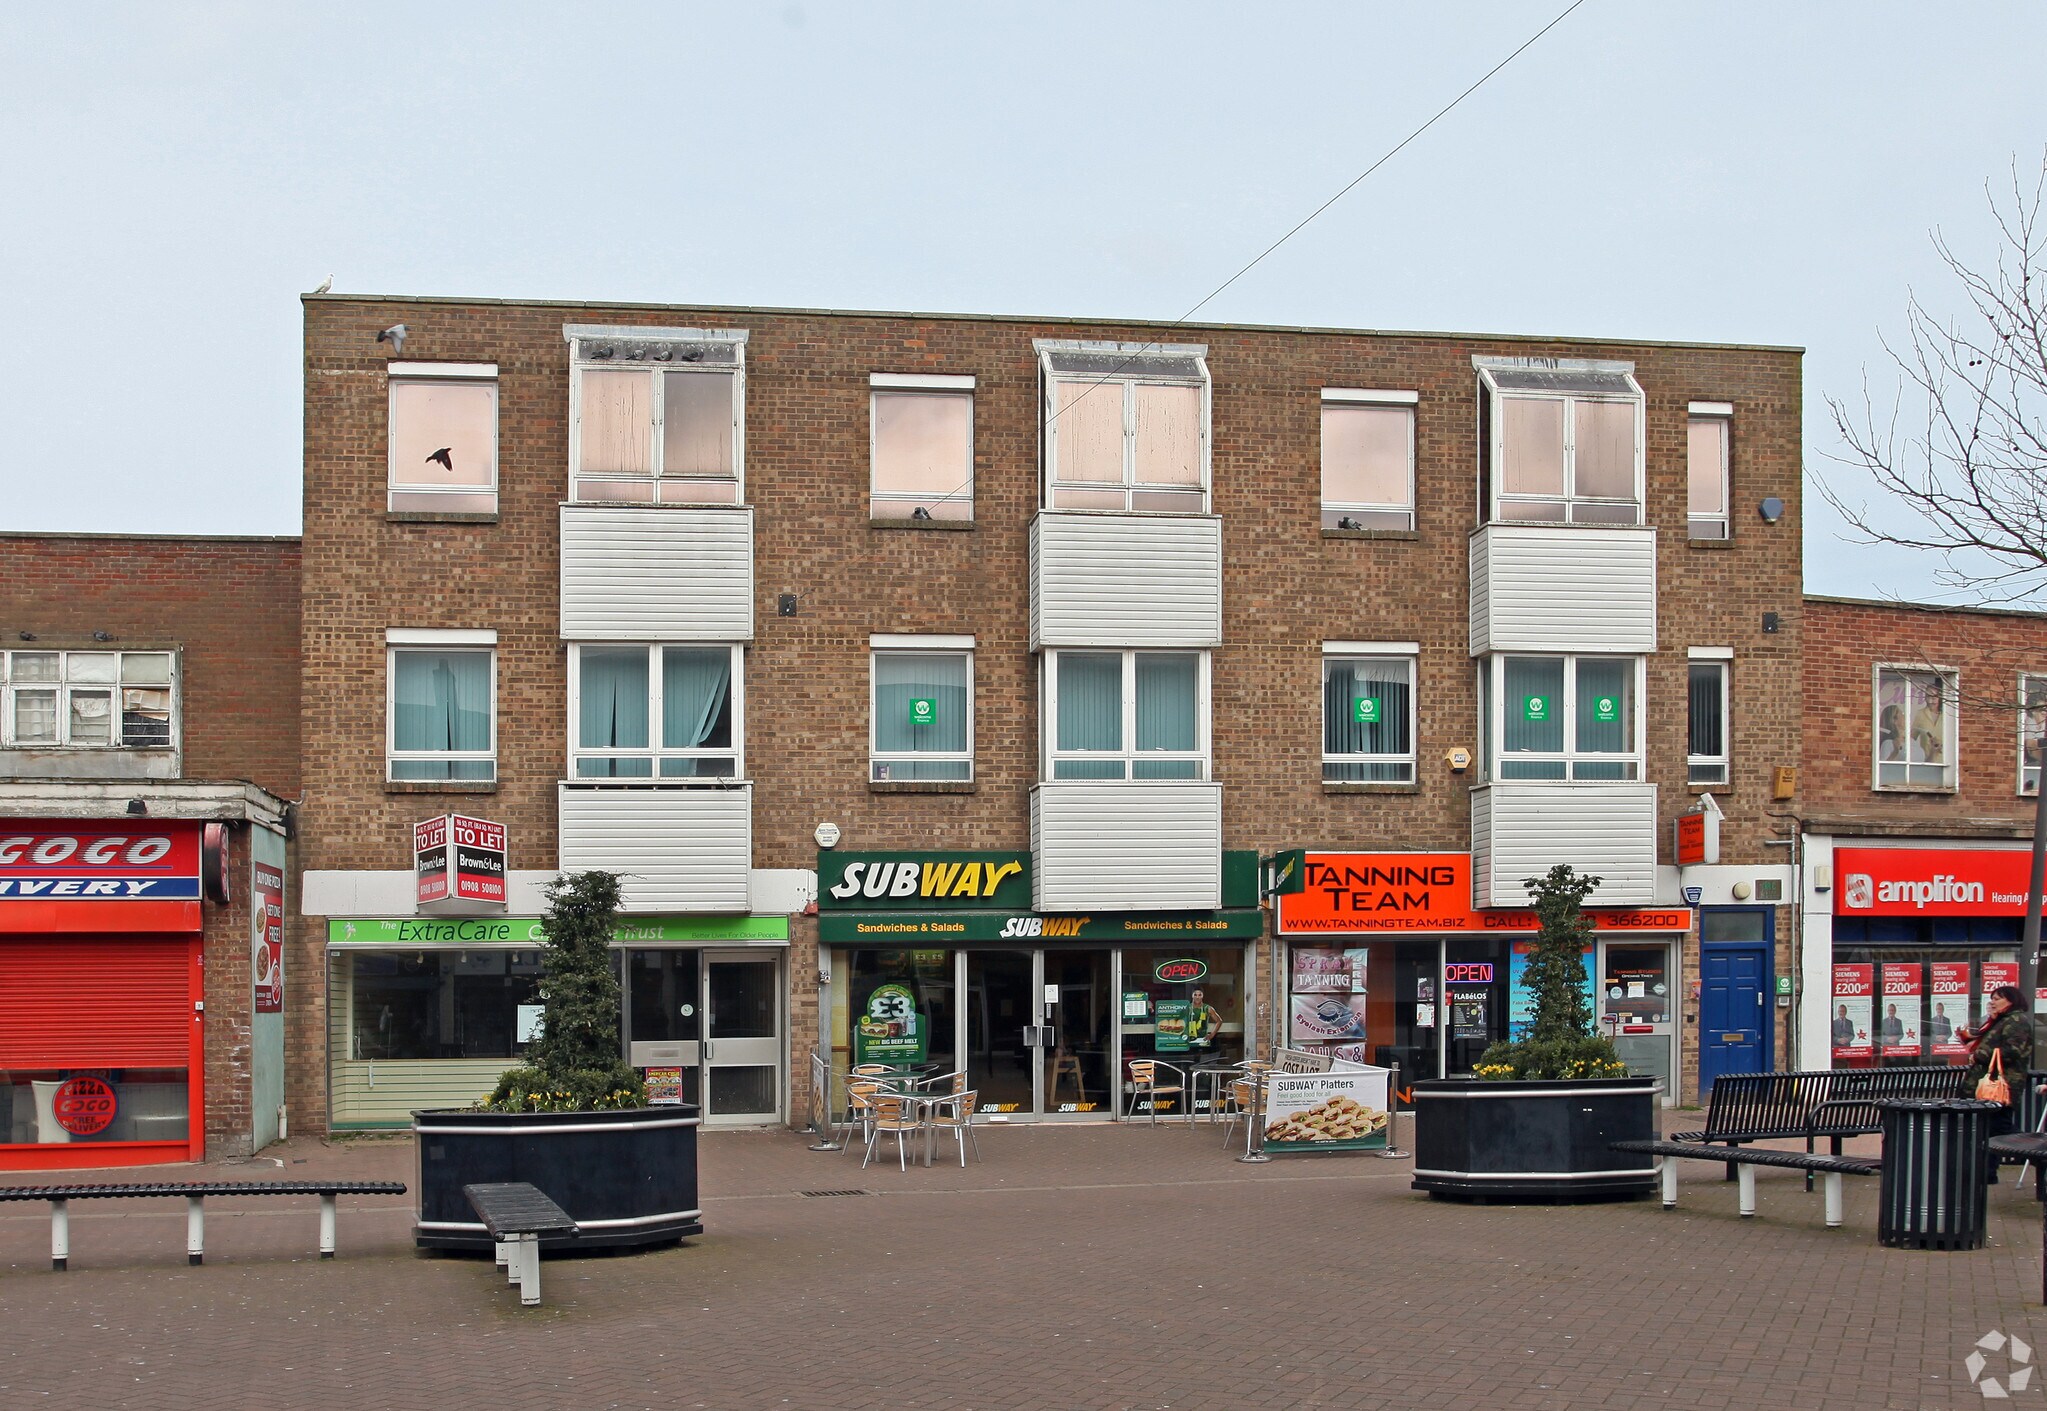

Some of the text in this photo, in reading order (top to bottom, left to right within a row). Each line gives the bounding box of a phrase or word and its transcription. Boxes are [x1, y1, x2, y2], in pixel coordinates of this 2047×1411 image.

[417, 828, 445, 850] TO LET
[455, 827, 475, 844] TO
[480, 832, 502, 849] LET
[0, 837, 172, 864] GOGO
[460, 854, 501, 871] Brown&Lee
[830, 860, 1022, 899] SUBWAY
[1305, 863, 1454, 886] TANNING
[461, 880, 478, 892] 01908
[1878, 875, 1984, 908] amplifon
[1992, 892, 2022, 905] Hearing
[1323, 888, 1430, 911] TEAM
[857, 923, 964, 932] Sandwiches & Salads
[1000, 916, 1091, 938] SUBWAY
[1125, 920, 1228, 930] Sandwiches & Salads
[1286, 918, 1465, 928] WWW.TANNINGTEAM.BIZ
[1484, 916, 1532, 928] CALL:
[1607, 915, 1678, 926] 366200
[380, 921, 396, 930] The
[398, 920, 510, 941] ExtraCare
[1161, 963, 1199, 978] OPEN
[1298, 956, 1352, 970] SPRAY
[1297, 974, 1350, 986] TANNING
[1445, 965, 1491, 980] OPEN
[1836, 983, 1861, 994] £200
[1885, 982, 1910, 994] £200
[1933, 982, 1958, 992] £200
[871, 996, 910, 1018] £3
[1296, 1012, 1362, 1035] Eyelash Extension
[1352, 1046, 1363, 1062] &
[64, 1081, 105, 1096] PIZZA
[1321, 1080, 1354, 1090] Platters
[980, 1102, 1020, 1112] SUBWAY
[1058, 1102, 1097, 1112] SUBWAY
